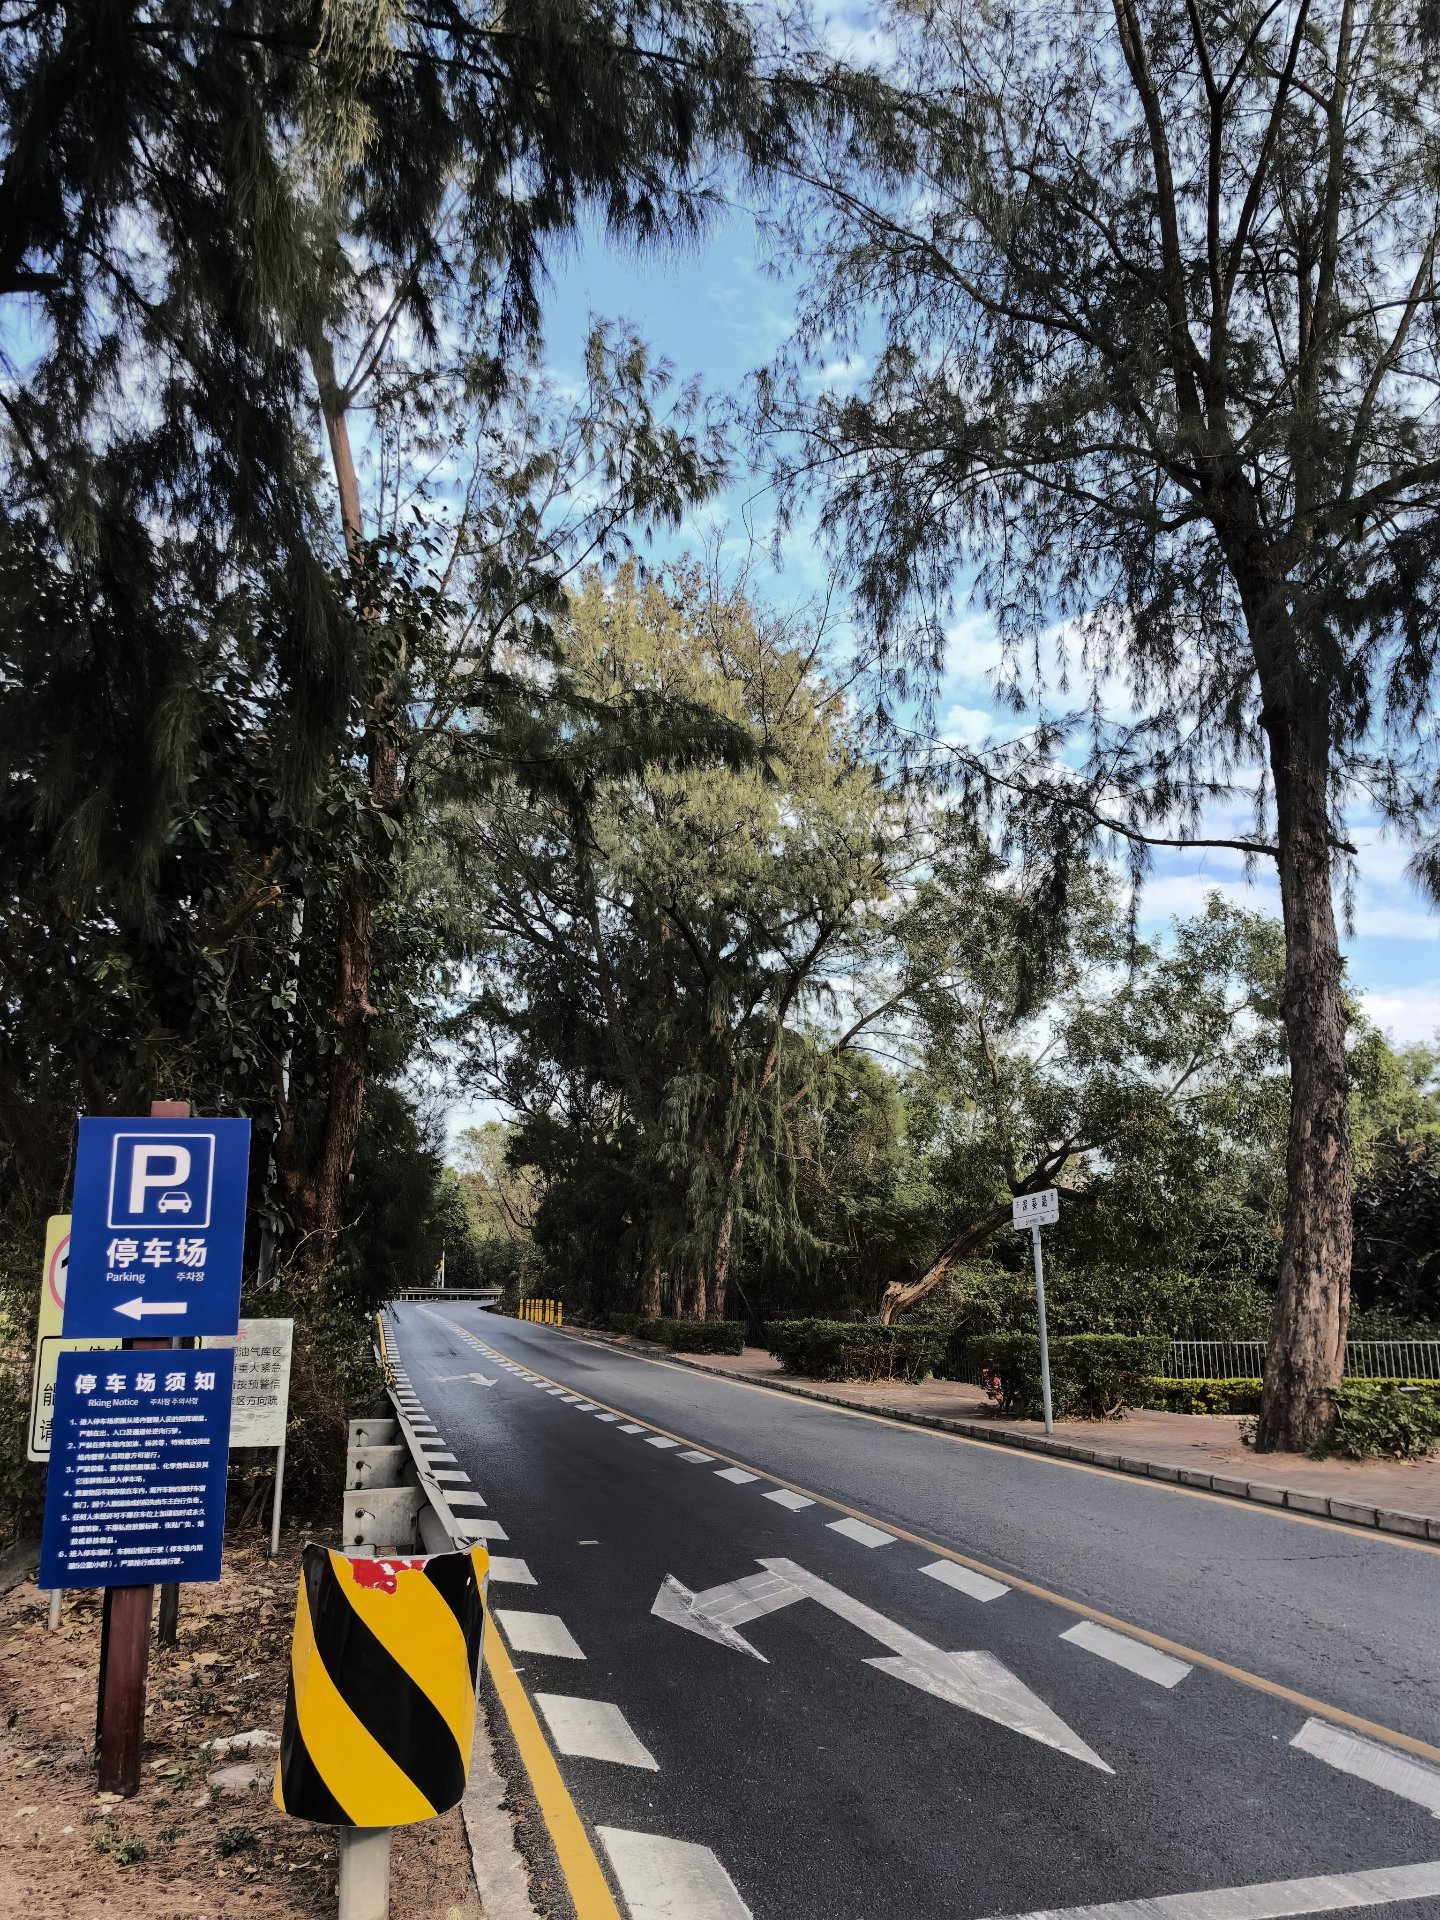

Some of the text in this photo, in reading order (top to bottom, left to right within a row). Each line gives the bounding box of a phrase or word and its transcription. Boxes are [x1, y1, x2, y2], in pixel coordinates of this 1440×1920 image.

[129, 1145, 191, 1213] P
[106, 1237, 207, 1268] 停车场
[106, 1272, 146, 1284] Parking
[176, 1272, 205, 1282] 주차장
[75, 1371, 215, 1394] 停车场须知
[88, 1398, 139, 1408] Rking Notice
